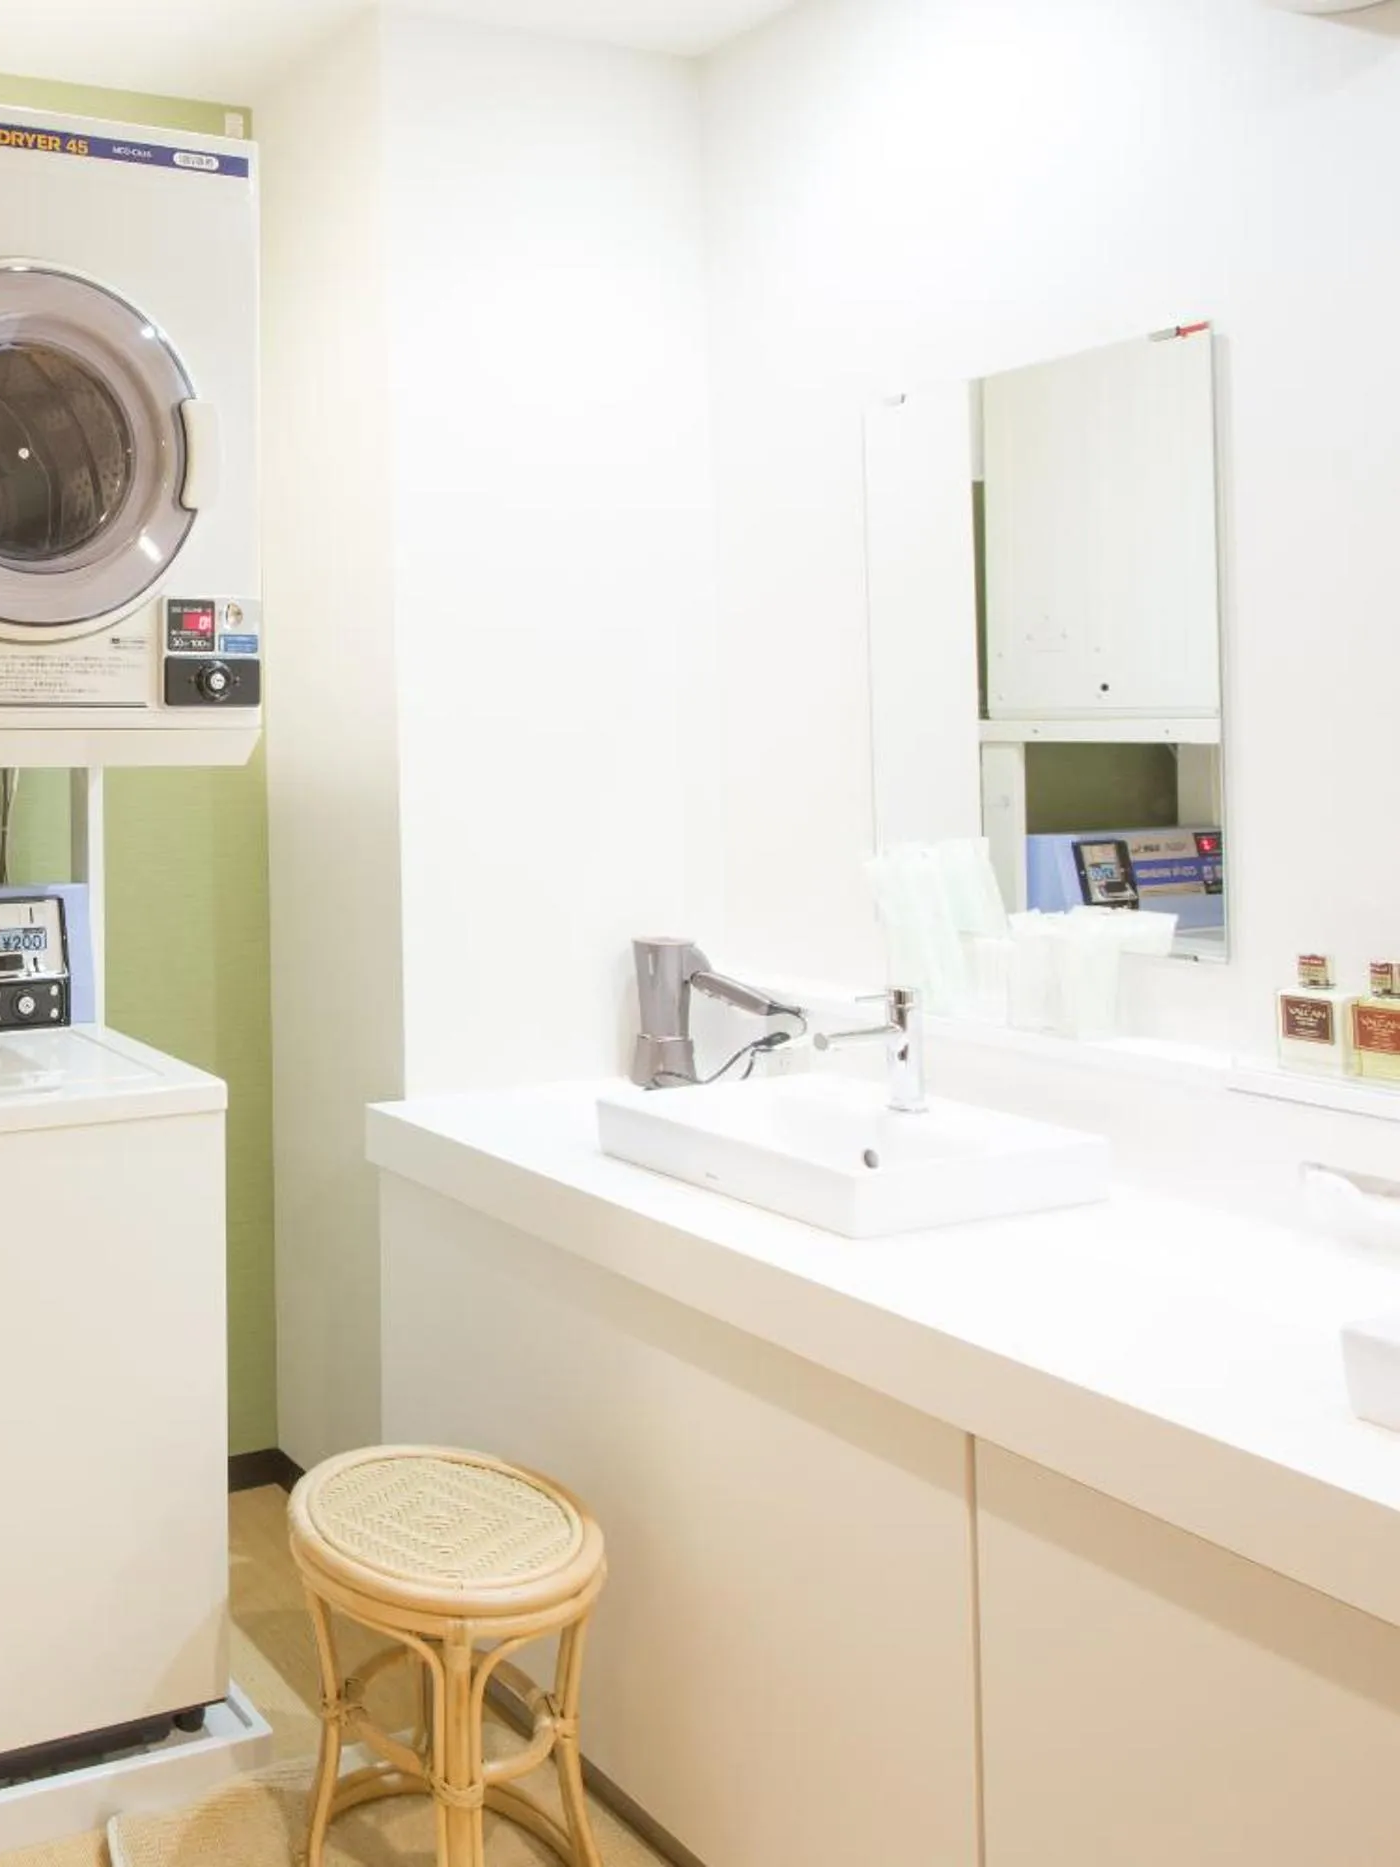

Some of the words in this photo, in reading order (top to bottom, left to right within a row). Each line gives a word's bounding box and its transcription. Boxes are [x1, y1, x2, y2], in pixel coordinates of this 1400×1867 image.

[65, 138, 89, 156] 45
[199, 615, 209, 630] 0
[2, 934, 42, 950] ¥200
